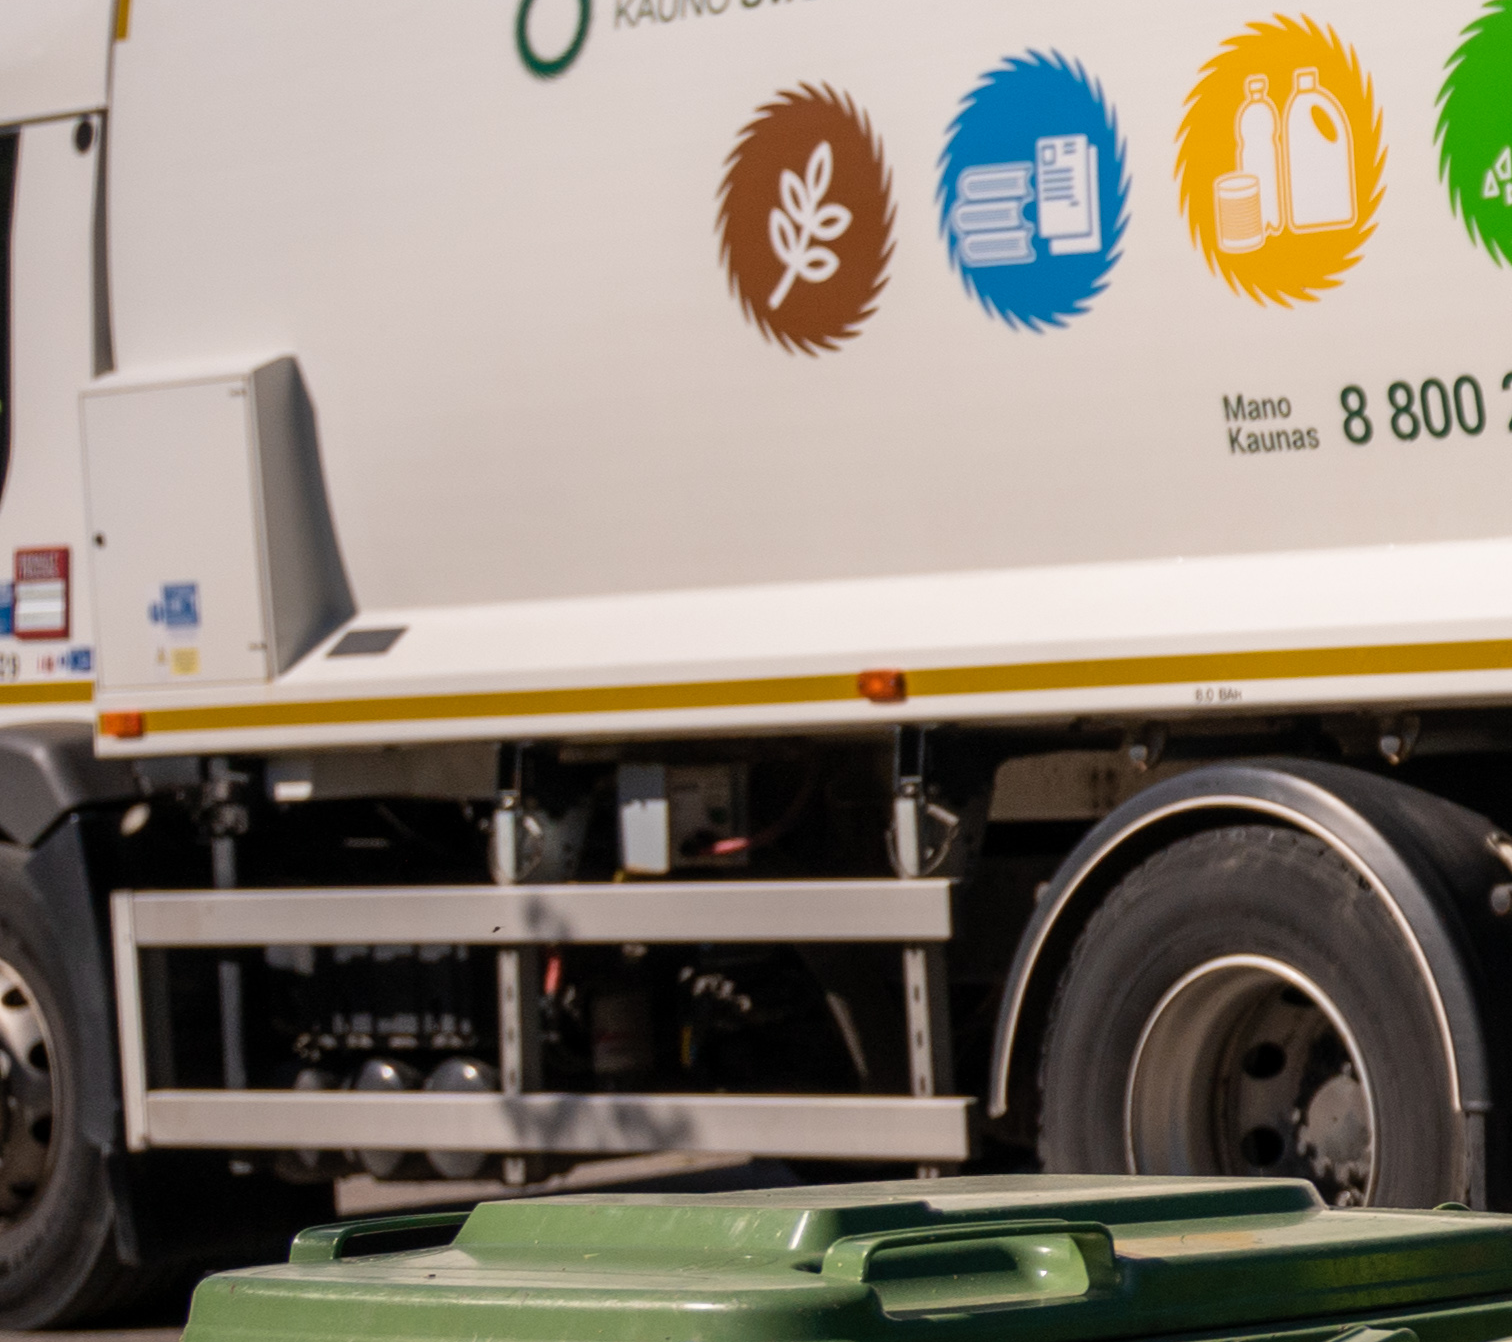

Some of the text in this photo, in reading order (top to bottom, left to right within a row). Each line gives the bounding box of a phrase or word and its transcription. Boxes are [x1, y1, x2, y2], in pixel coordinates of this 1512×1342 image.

[1222, 393, 1292, 422] Mano
[1339, 384, 1374, 445] 8
[1386, 373, 1487, 442] 800
[1227, 424, 1320, 455] Kaunas
